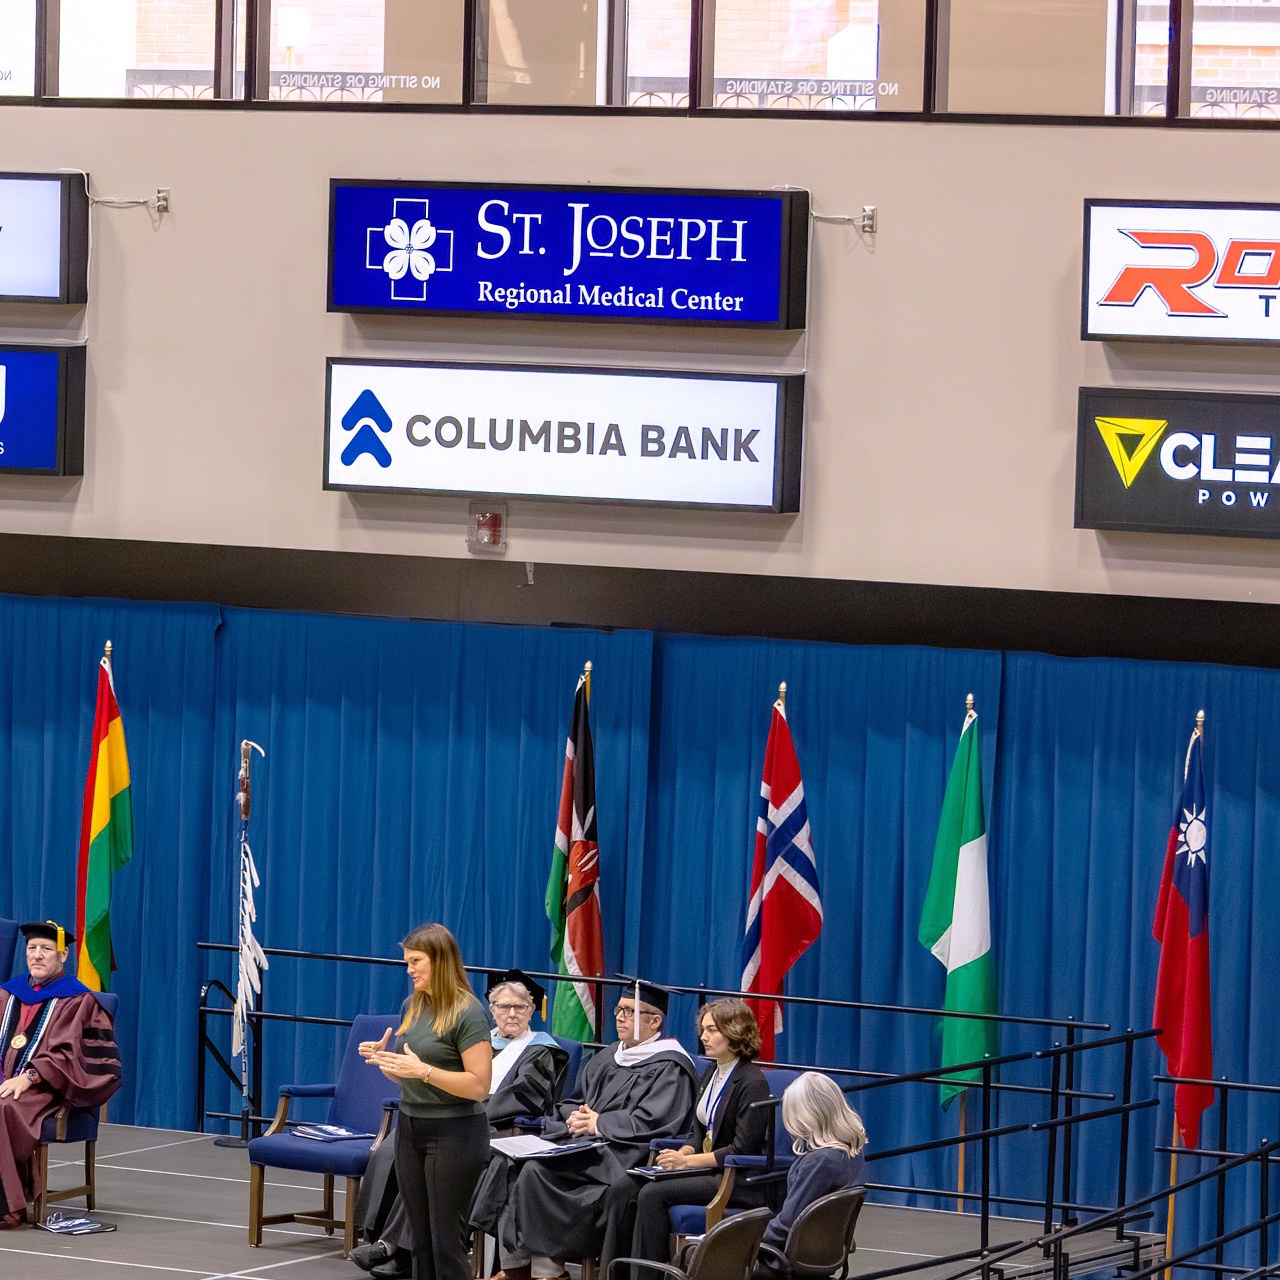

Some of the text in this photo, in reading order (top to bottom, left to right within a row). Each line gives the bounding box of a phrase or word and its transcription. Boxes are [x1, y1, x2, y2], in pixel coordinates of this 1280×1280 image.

[477, 281, 743, 312] Regional Medical Center
[406, 414, 761, 463] COLUMBIA BANK
